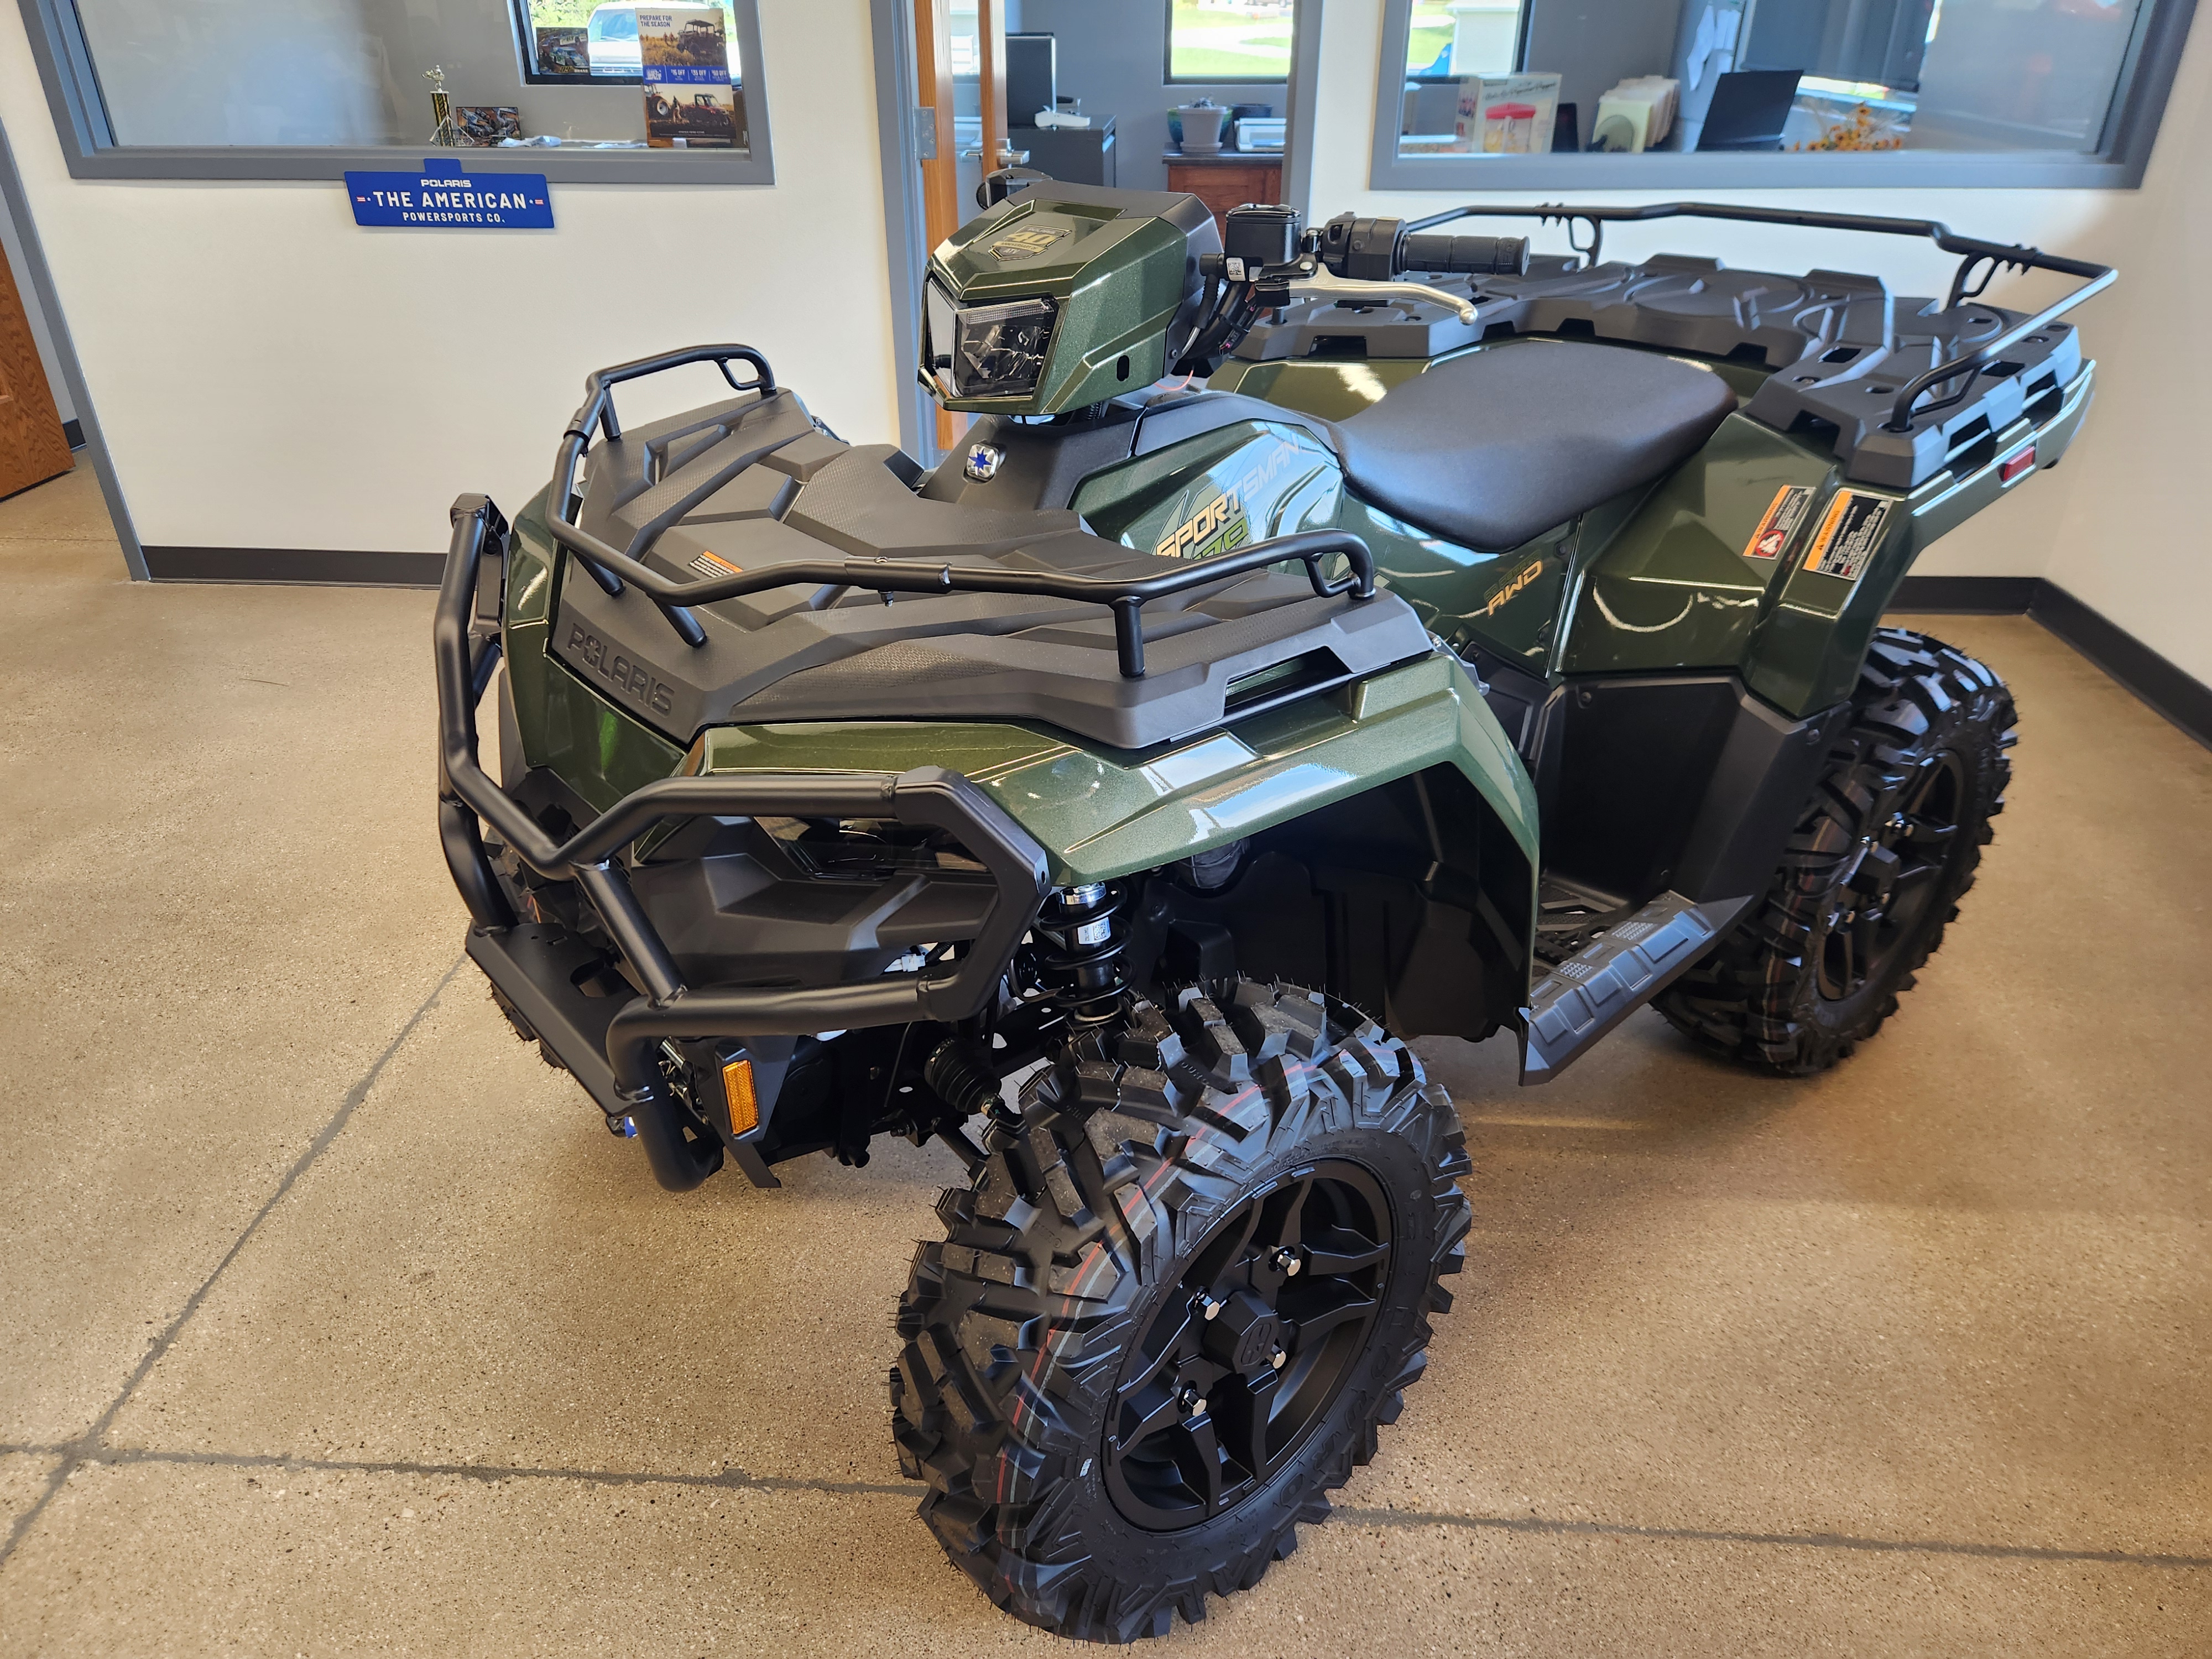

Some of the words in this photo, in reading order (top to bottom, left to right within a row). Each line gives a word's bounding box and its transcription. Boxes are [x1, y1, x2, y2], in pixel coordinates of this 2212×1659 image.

[420, 179, 472, 188] POLARIS
[372, 191, 414, 207] THE
[422, 192, 526, 210] AMERICAN
[403, 212, 483, 223] POWERSPORTS
[486, 213, 506, 223] CO.
[1006, 232, 1057, 244] 40
[1156, 432, 1300, 558] SPORTSMAN
[1193, 517, 1249, 560] 70
[1819, 510, 1840, 542] WARNING
[1488, 560, 1543, 617] AWD
[566, 623, 675, 718] POLARIS
